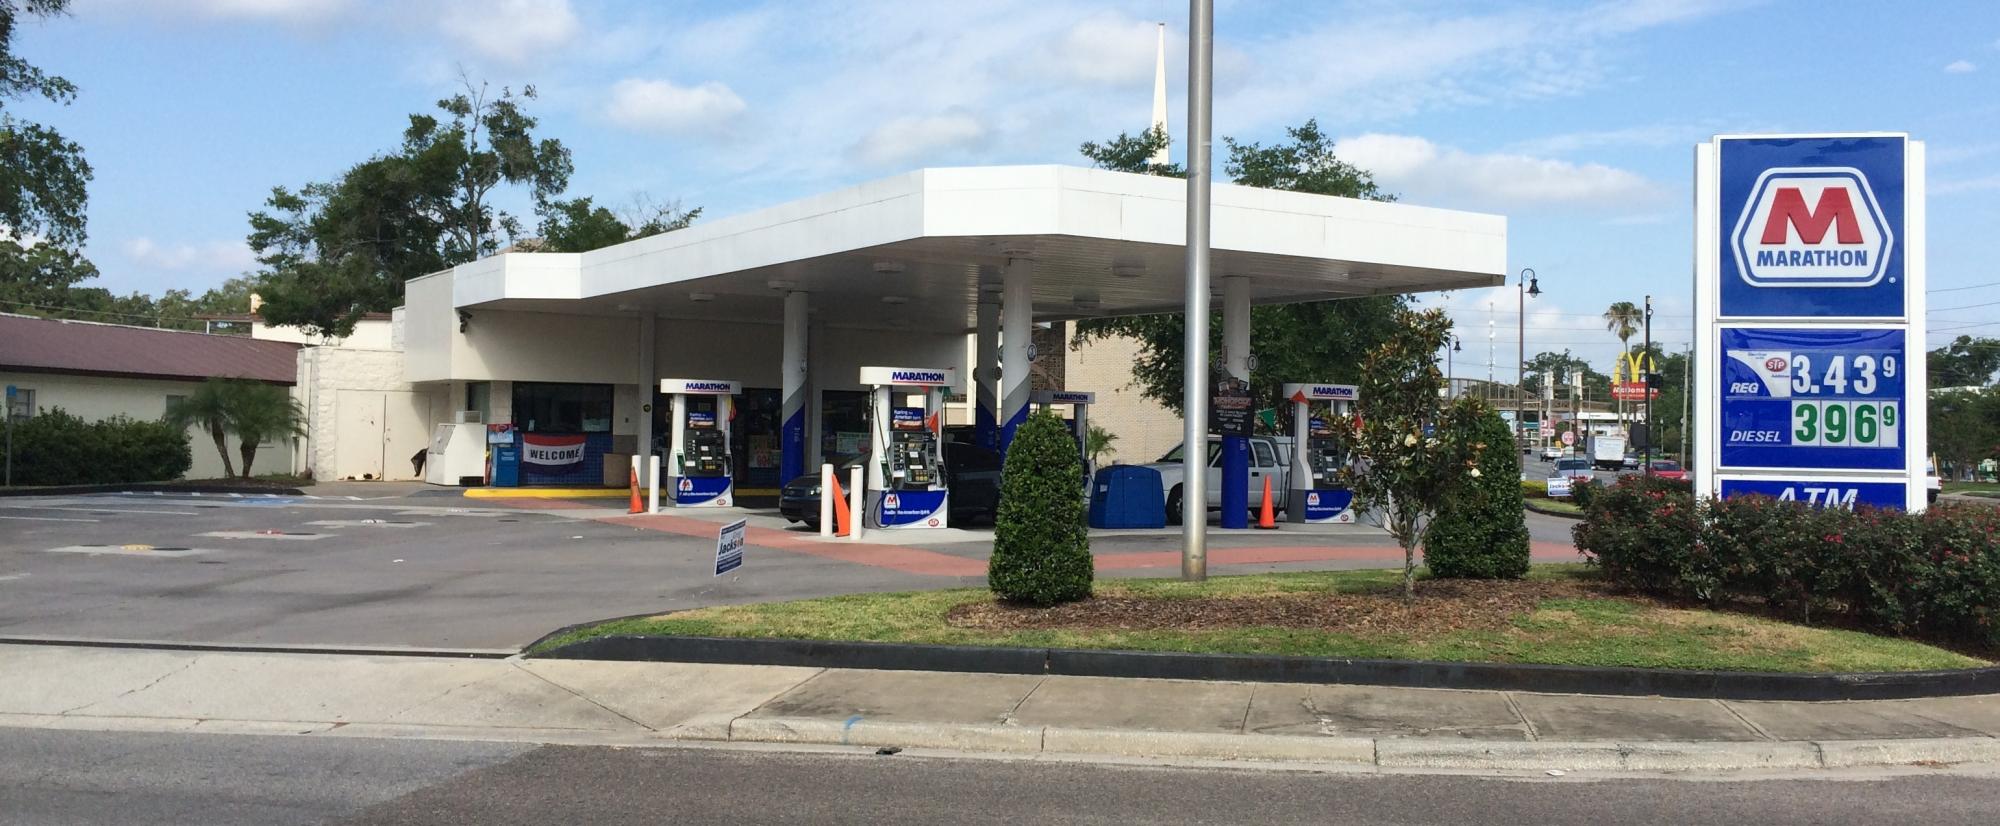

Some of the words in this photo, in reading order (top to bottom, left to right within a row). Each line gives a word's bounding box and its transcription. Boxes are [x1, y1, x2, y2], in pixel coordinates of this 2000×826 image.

[1756, 250, 1868, 267] MARATHON
[1767, 359, 1785, 370] STP
[892, 371, 945, 382] MARATHON
[685, 382, 731, 391] MARATHON
[1312, 387, 1353, 396] MARATHON
[1730, 382, 1760, 394] REG
[1053, 393, 1089, 401] MARATHON
[1730, 430, 1782, 442] DIESEL
[530, 449, 580, 460] WELCOME
[1777, 486, 1859, 512] ATM
